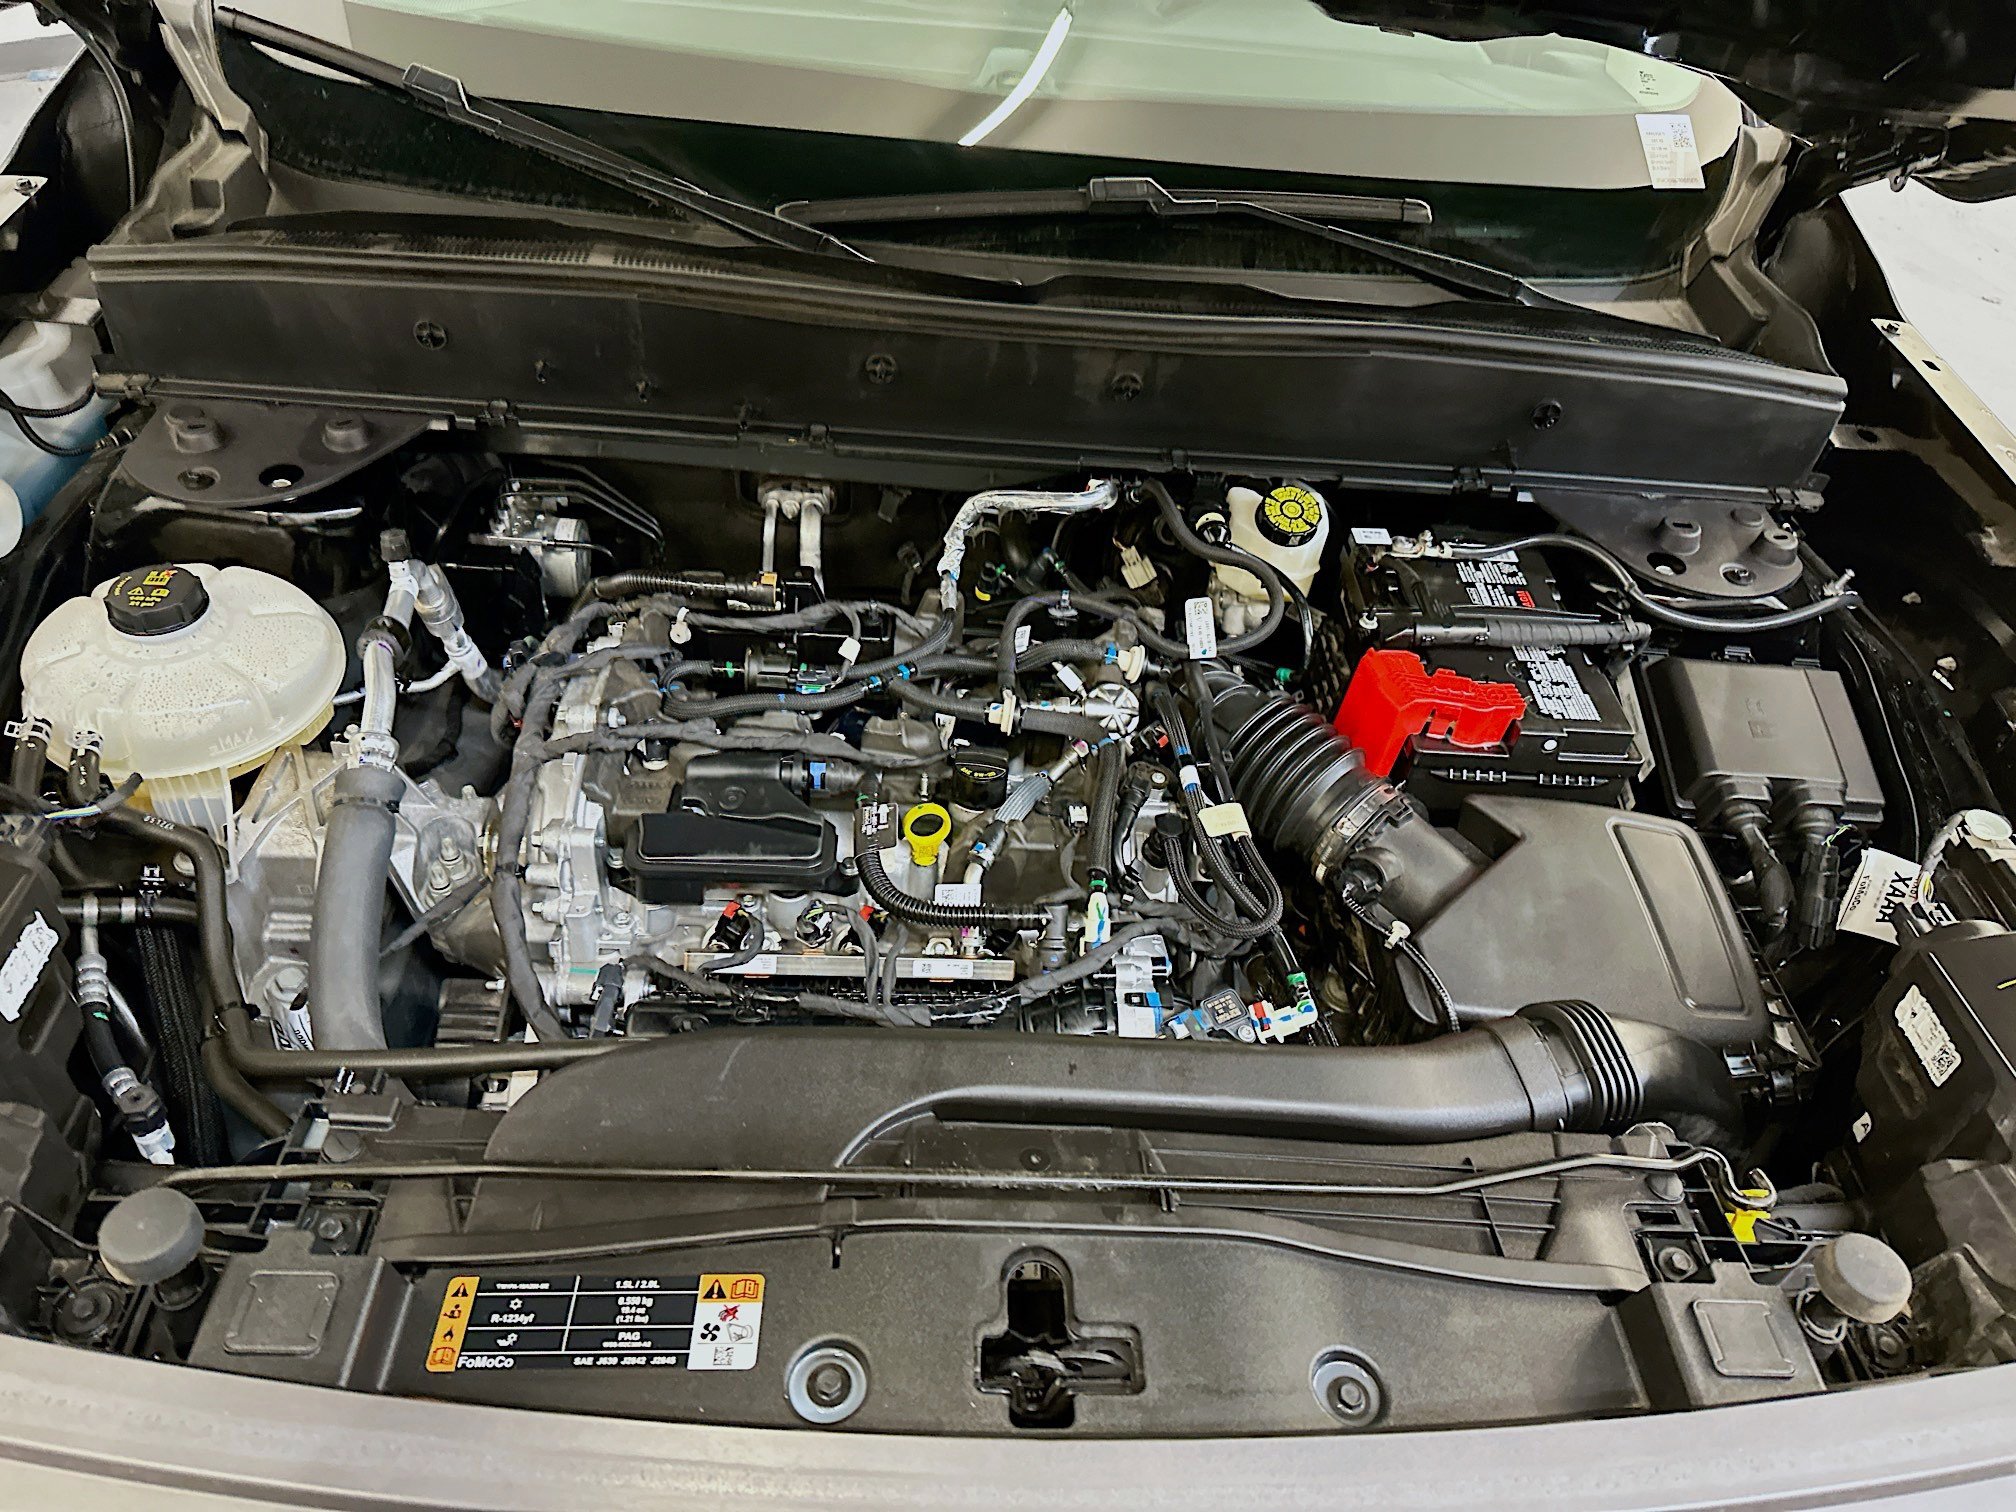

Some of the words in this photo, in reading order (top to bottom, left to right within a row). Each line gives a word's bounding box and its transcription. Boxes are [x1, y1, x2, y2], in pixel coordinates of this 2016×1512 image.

[1849, 875, 1870, 911] FoMoCo
[490, 1313, 535, 1325] R-1234yf
[617, 1331, 641, 1341] PAG
[457, 1355, 514, 1368] FoMoCo
